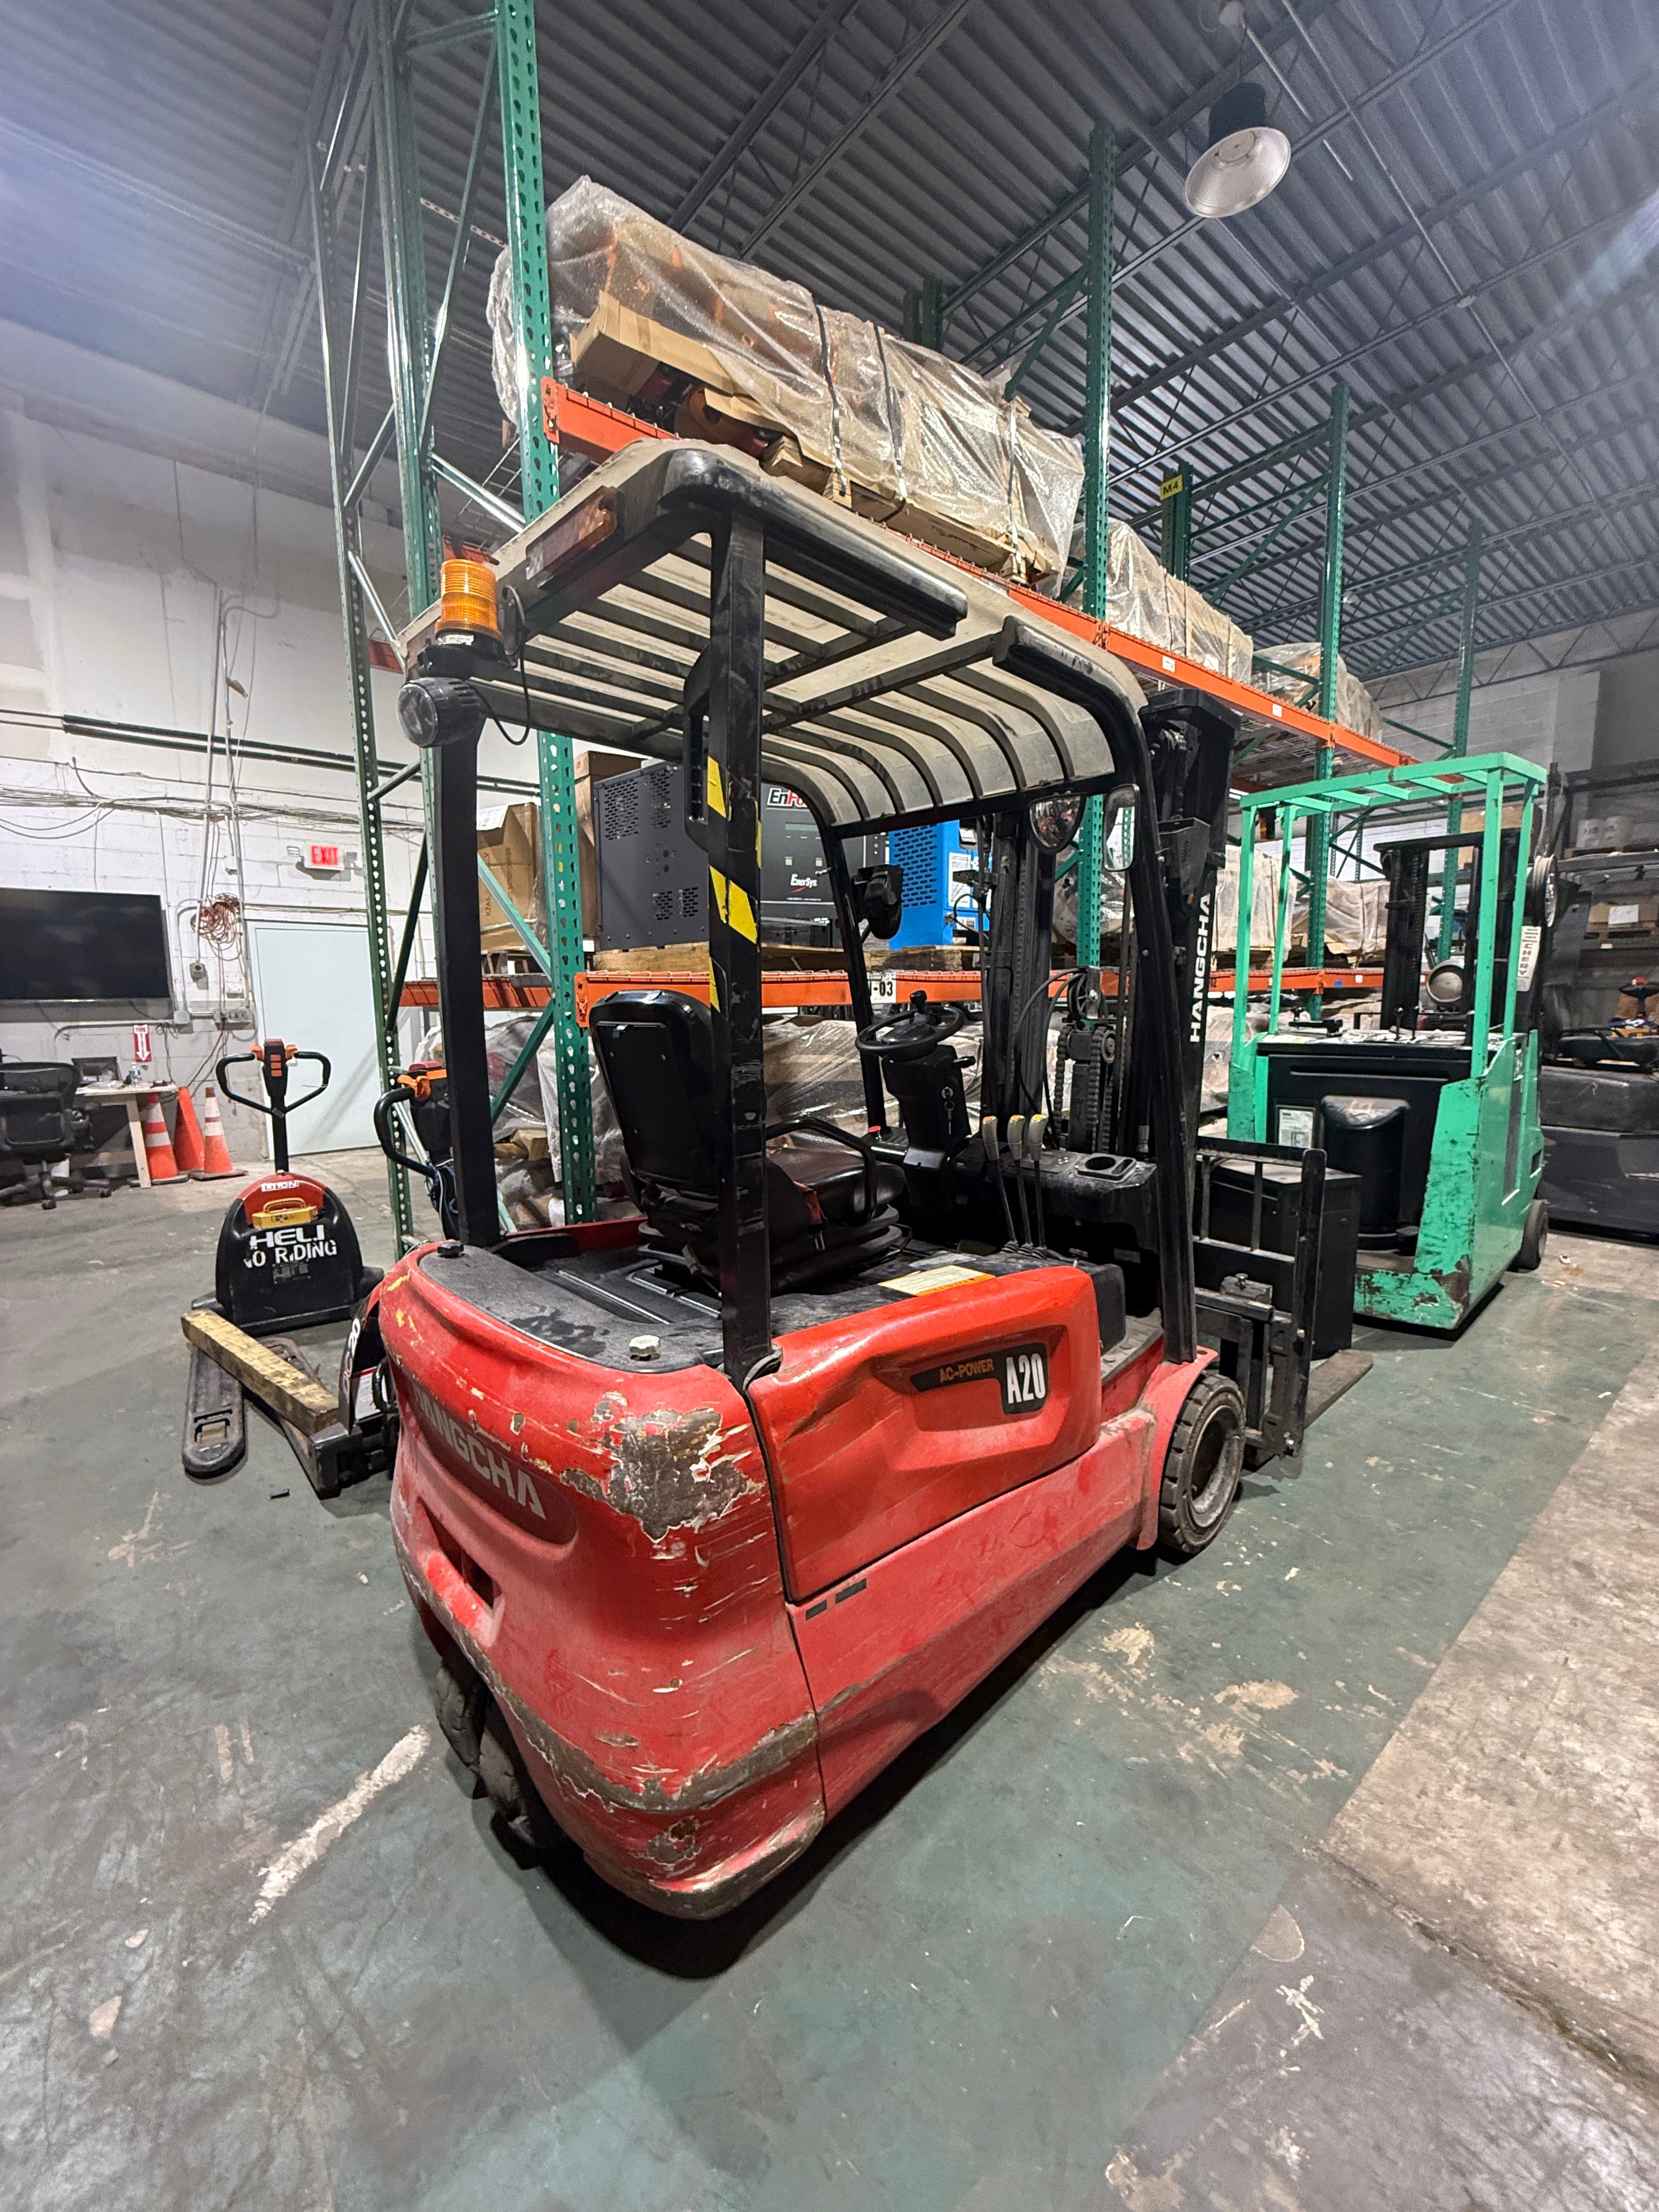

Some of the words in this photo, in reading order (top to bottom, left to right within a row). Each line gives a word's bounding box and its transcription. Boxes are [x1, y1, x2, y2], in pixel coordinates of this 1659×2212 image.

[1163, 481, 1178, 495] M4
[311, 845, 338, 865] EXIT
[791, 874, 817, 888] EnerSys
[1190, 893, 1210, 1042] HANGCHA
[870, 980, 893, 996] -03
[250, 1224, 325, 1250] HELI
[940, 1358, 994, 1383] AC-POWER
[1006, 1353, 1046, 1404] A20
